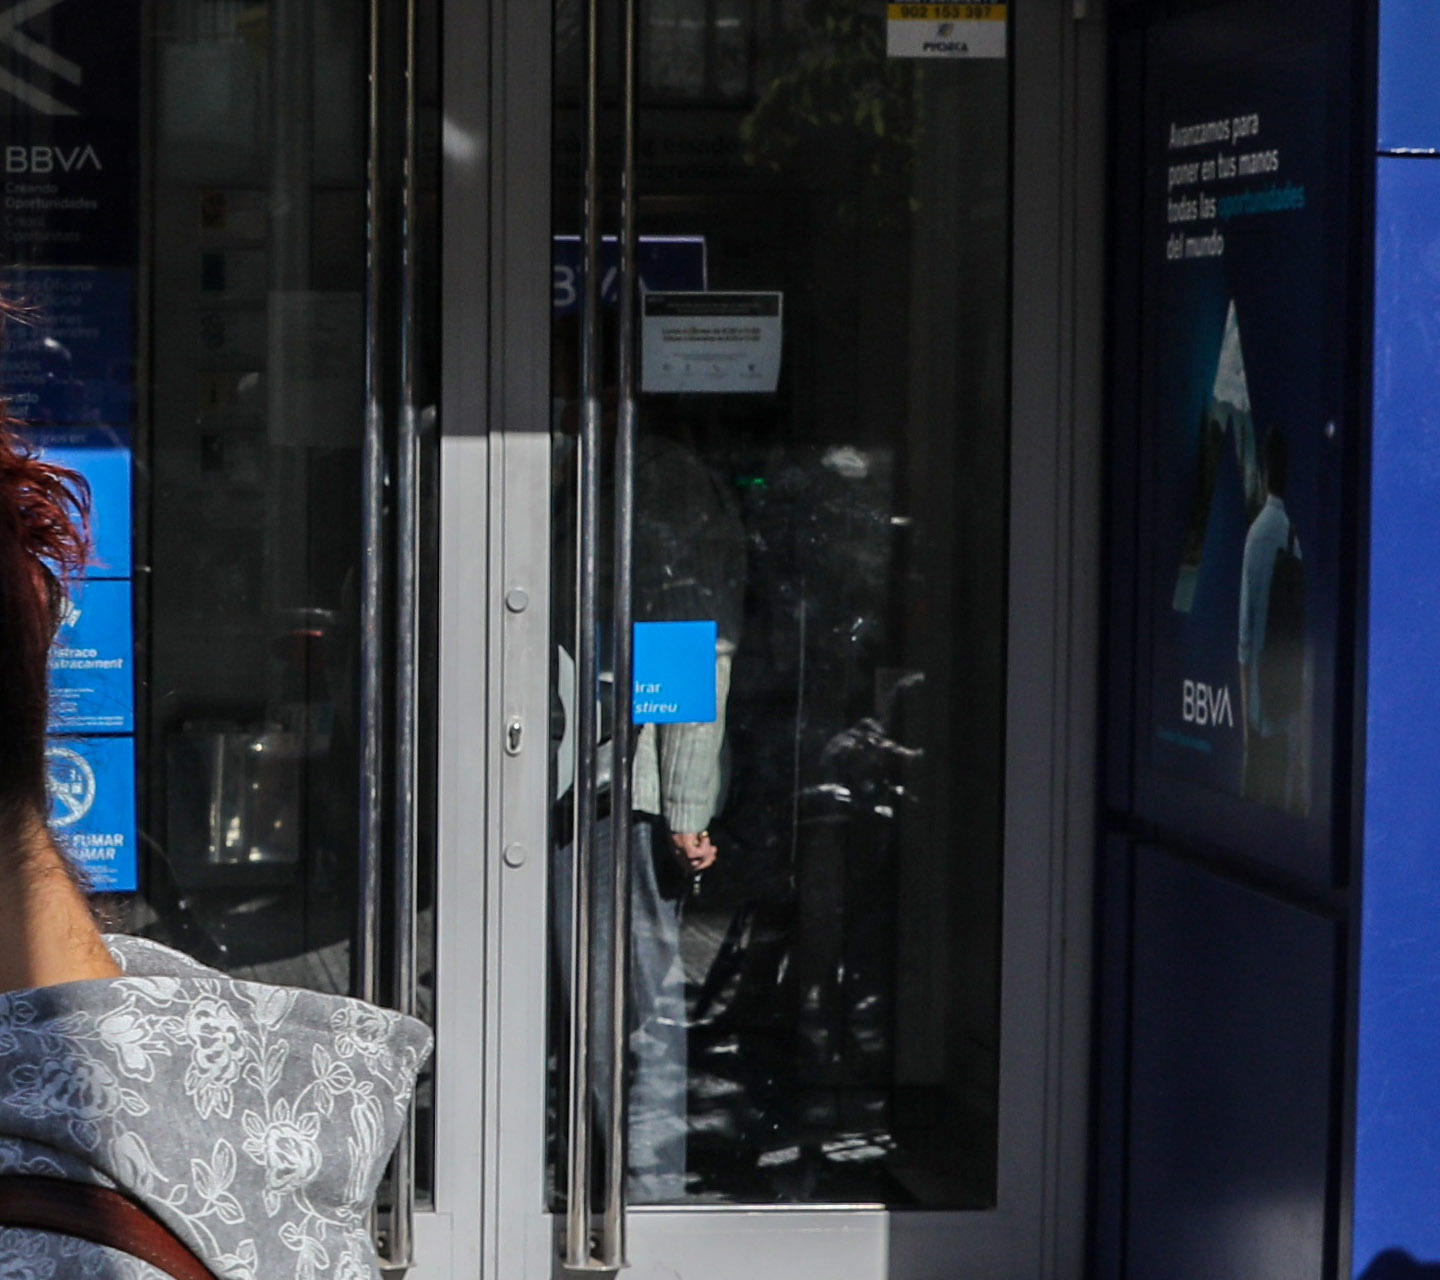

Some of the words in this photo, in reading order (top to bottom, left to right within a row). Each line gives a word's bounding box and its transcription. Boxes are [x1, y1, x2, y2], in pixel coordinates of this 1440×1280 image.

[901, 5, 928, 18] 902
[1232, 113, 1259, 146] para
[5, 143, 103, 174] BBVA
[1168, 162, 1200, 194] poner
[1201, 159, 1216, 182] en
[1218, 152, 1237, 179] tus
[1238, 150, 1279, 176] manos
[1168, 194, 1198, 224] todas
[1200, 192, 1217, 220] las
[1167, 232, 1184, 261] del
[1185, 228, 1225, 258] mundo
[633, 701, 677, 714] stireu
[1182, 678, 1234, 728] BBVA
